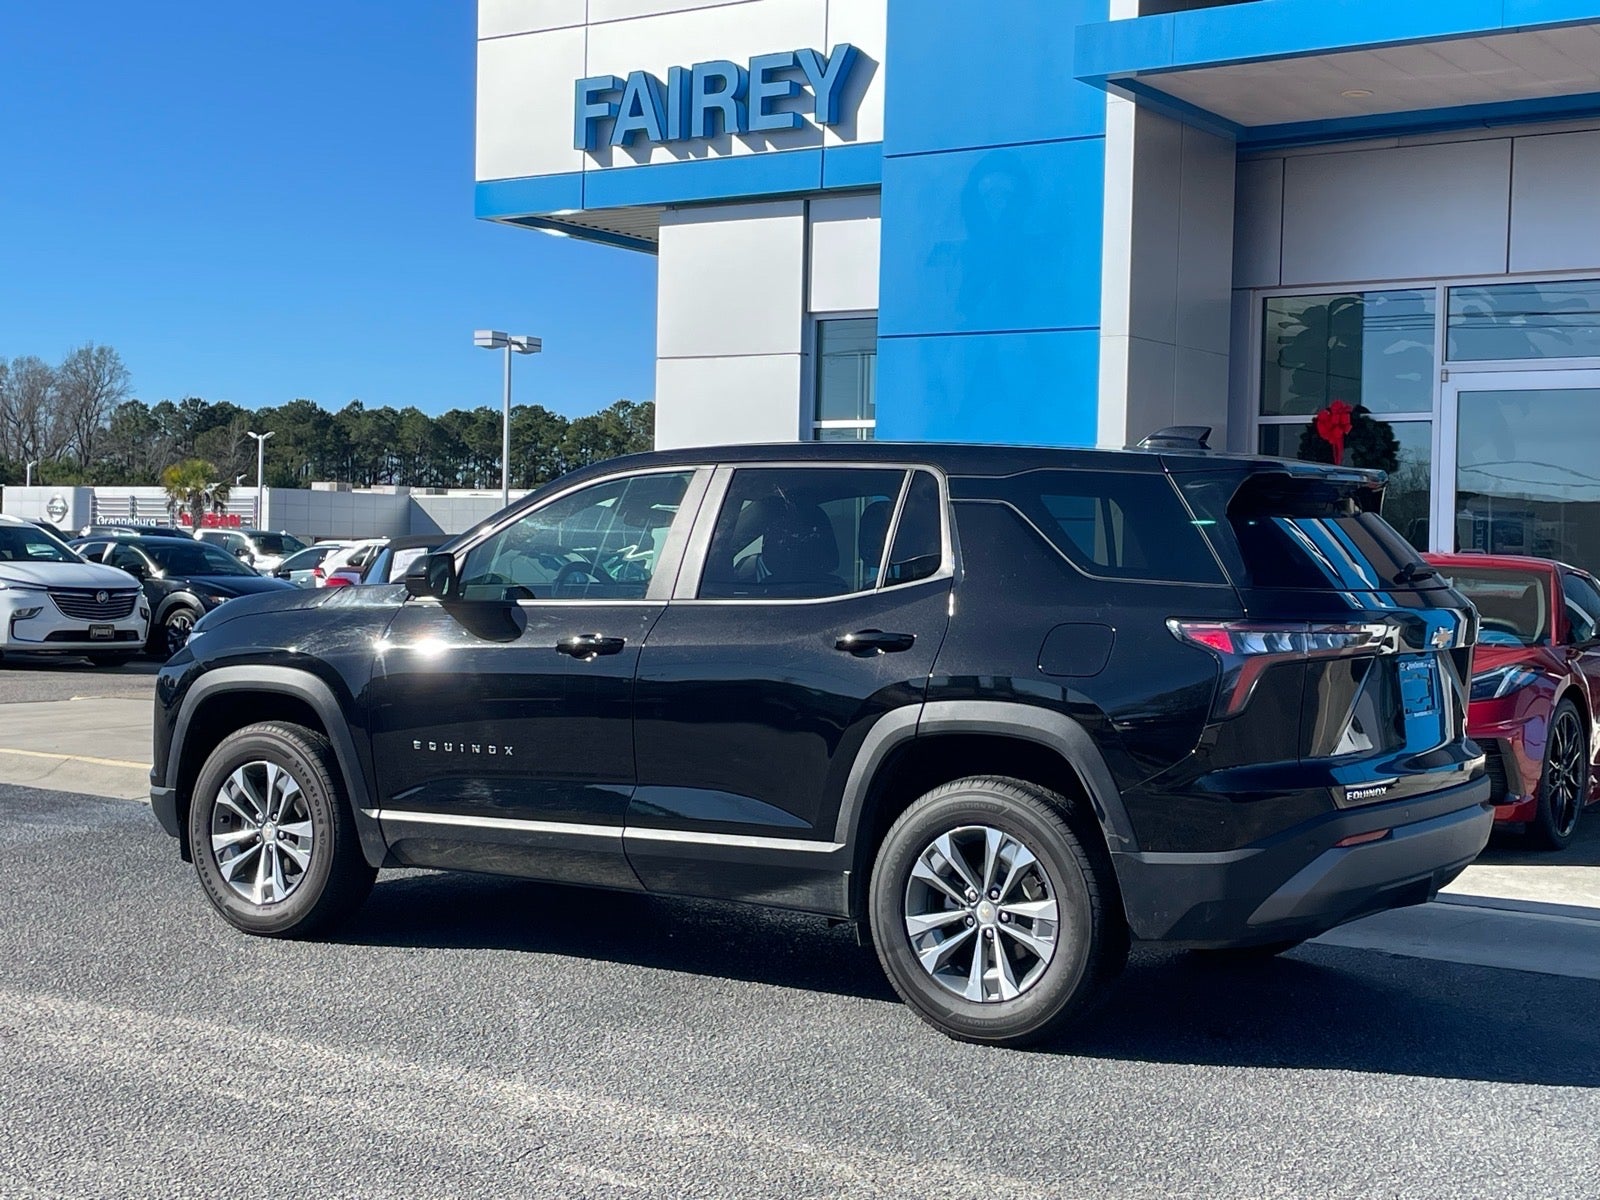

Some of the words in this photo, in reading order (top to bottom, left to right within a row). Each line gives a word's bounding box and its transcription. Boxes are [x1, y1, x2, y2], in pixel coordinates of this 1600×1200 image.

[574, 43, 851, 151] FAIREY
[181, 513, 241, 528] NSSAN
[413, 740, 513, 756] EQUINOX
[1346, 786, 1387, 801] EQUINOX
